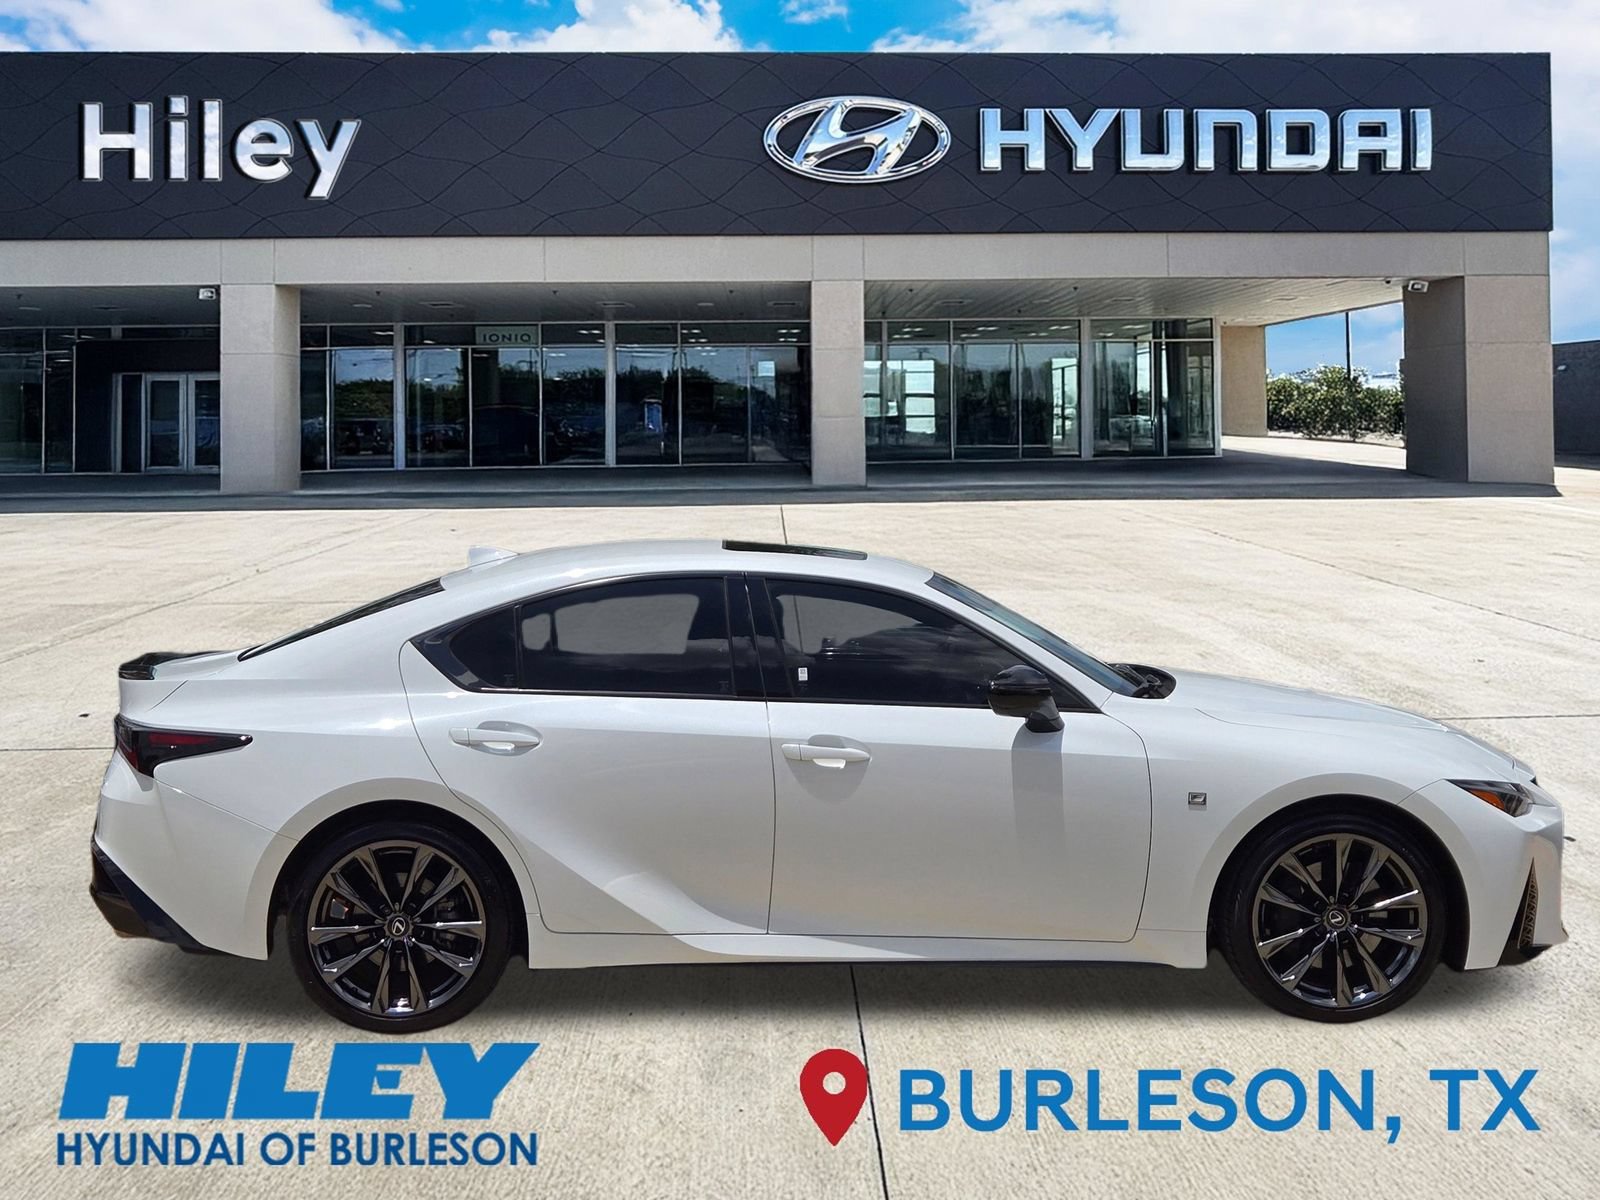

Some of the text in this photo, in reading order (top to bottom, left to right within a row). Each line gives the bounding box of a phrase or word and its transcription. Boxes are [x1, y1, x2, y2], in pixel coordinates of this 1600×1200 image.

[80, 95, 362, 200] Hiley
[979, 107, 1434, 173] HYUNDAI
[483, 333, 532, 343] IONIQ
